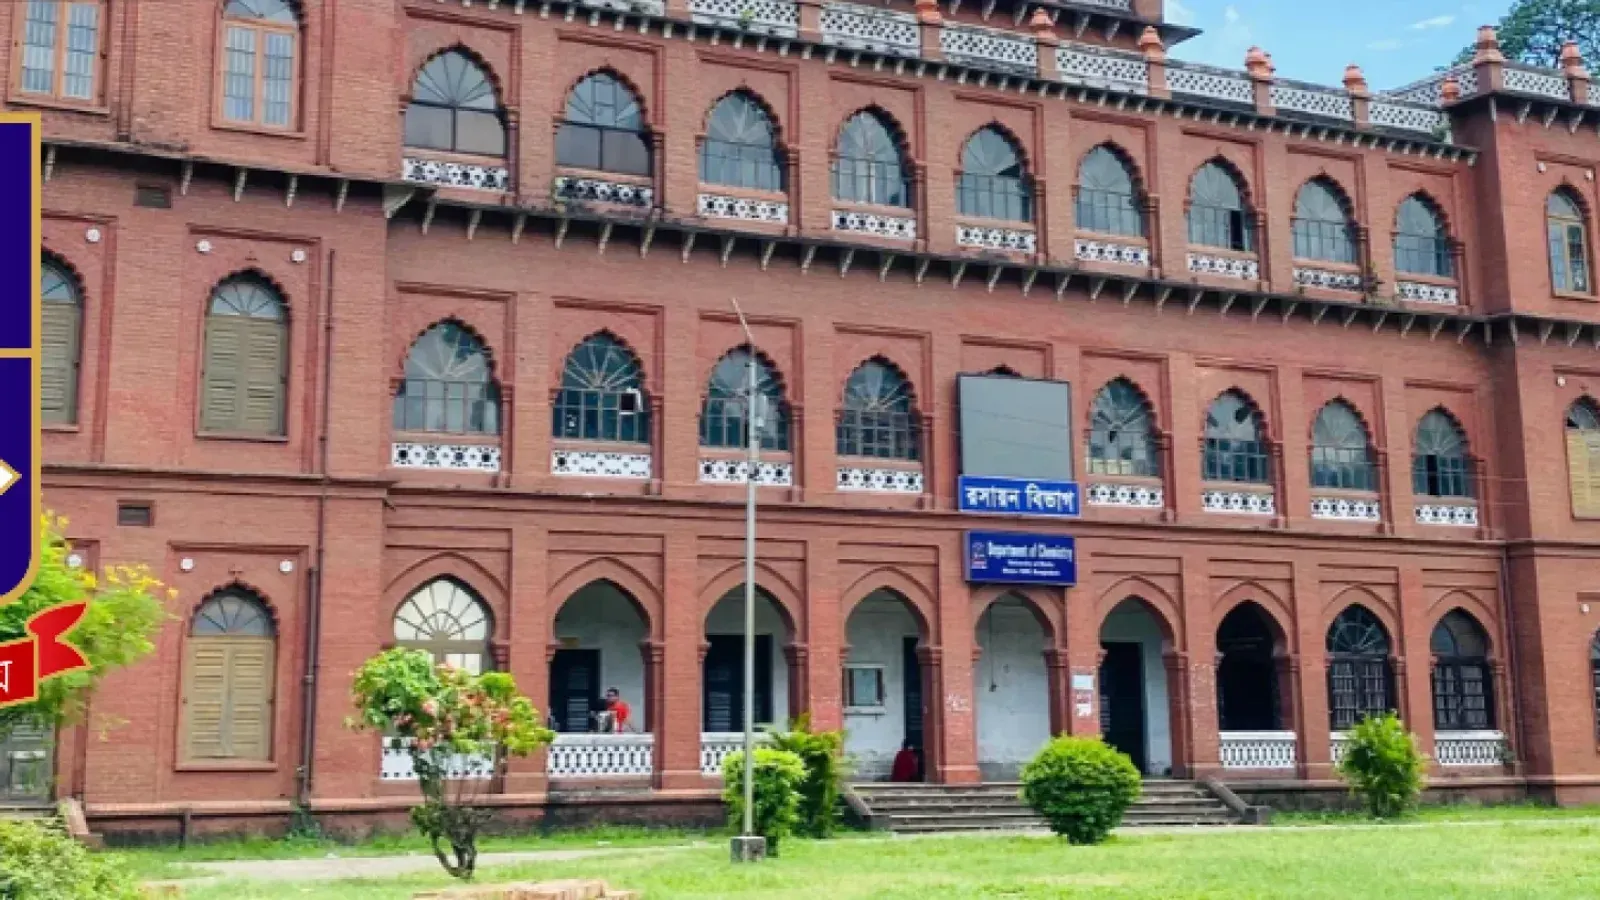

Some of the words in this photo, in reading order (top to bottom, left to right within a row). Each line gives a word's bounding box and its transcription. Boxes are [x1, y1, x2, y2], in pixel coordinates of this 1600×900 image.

[965, 485, 1020, 510] রসায়ন
[1024, 482, 1076, 513] বিভাগ
[988, 540, 1027, 559] Department
[1029, 543, 1037, 557] of
[1038, 543, 1073, 562] Chemistry
